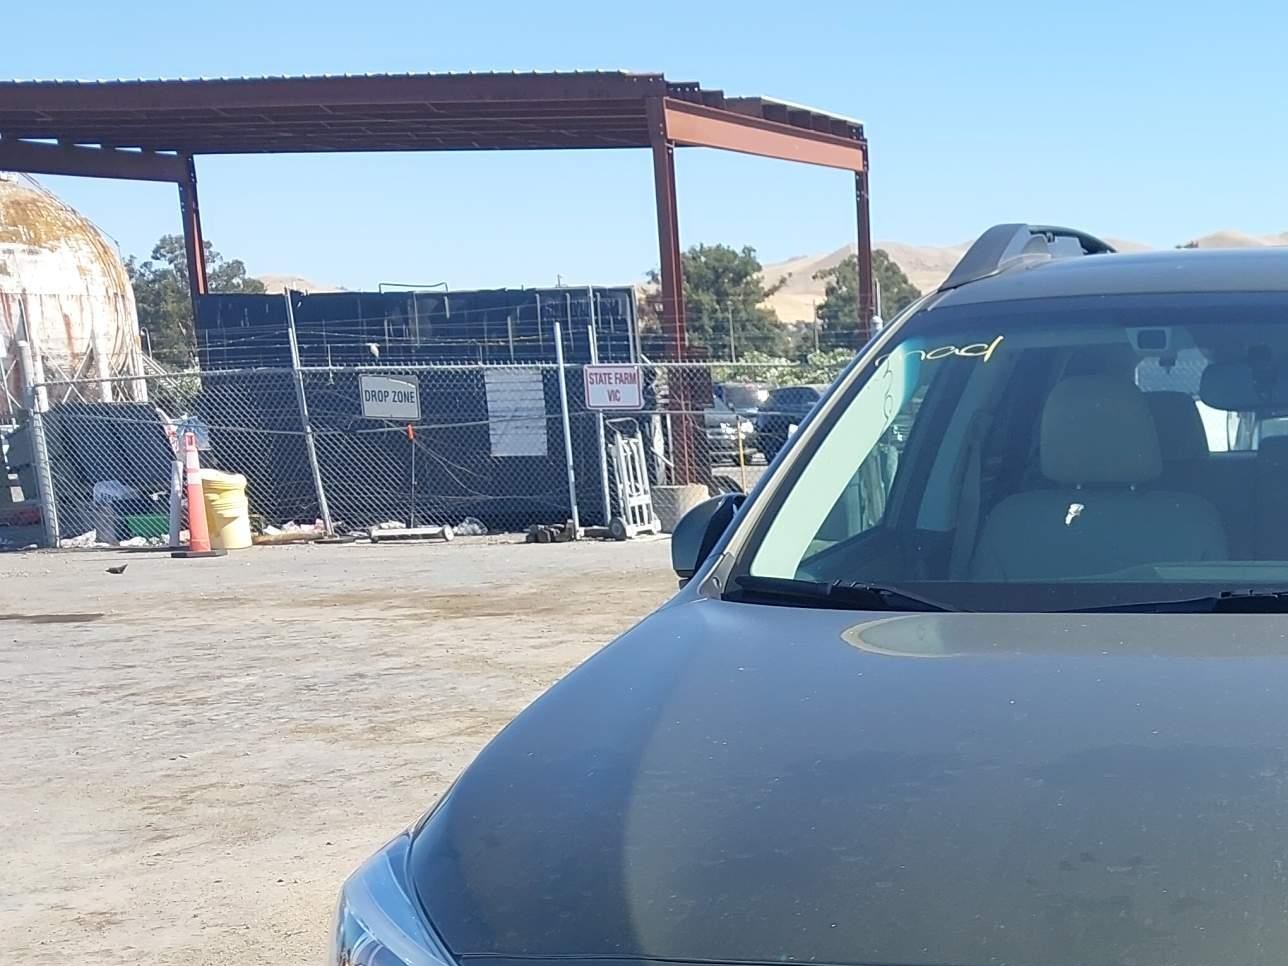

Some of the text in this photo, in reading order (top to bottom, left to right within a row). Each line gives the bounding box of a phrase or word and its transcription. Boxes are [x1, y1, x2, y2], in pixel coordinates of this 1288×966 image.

[588, 372, 637, 385] STATE FARM
[364, 389, 416, 404] DROP ZONE
[607, 389, 621, 402] VIC
